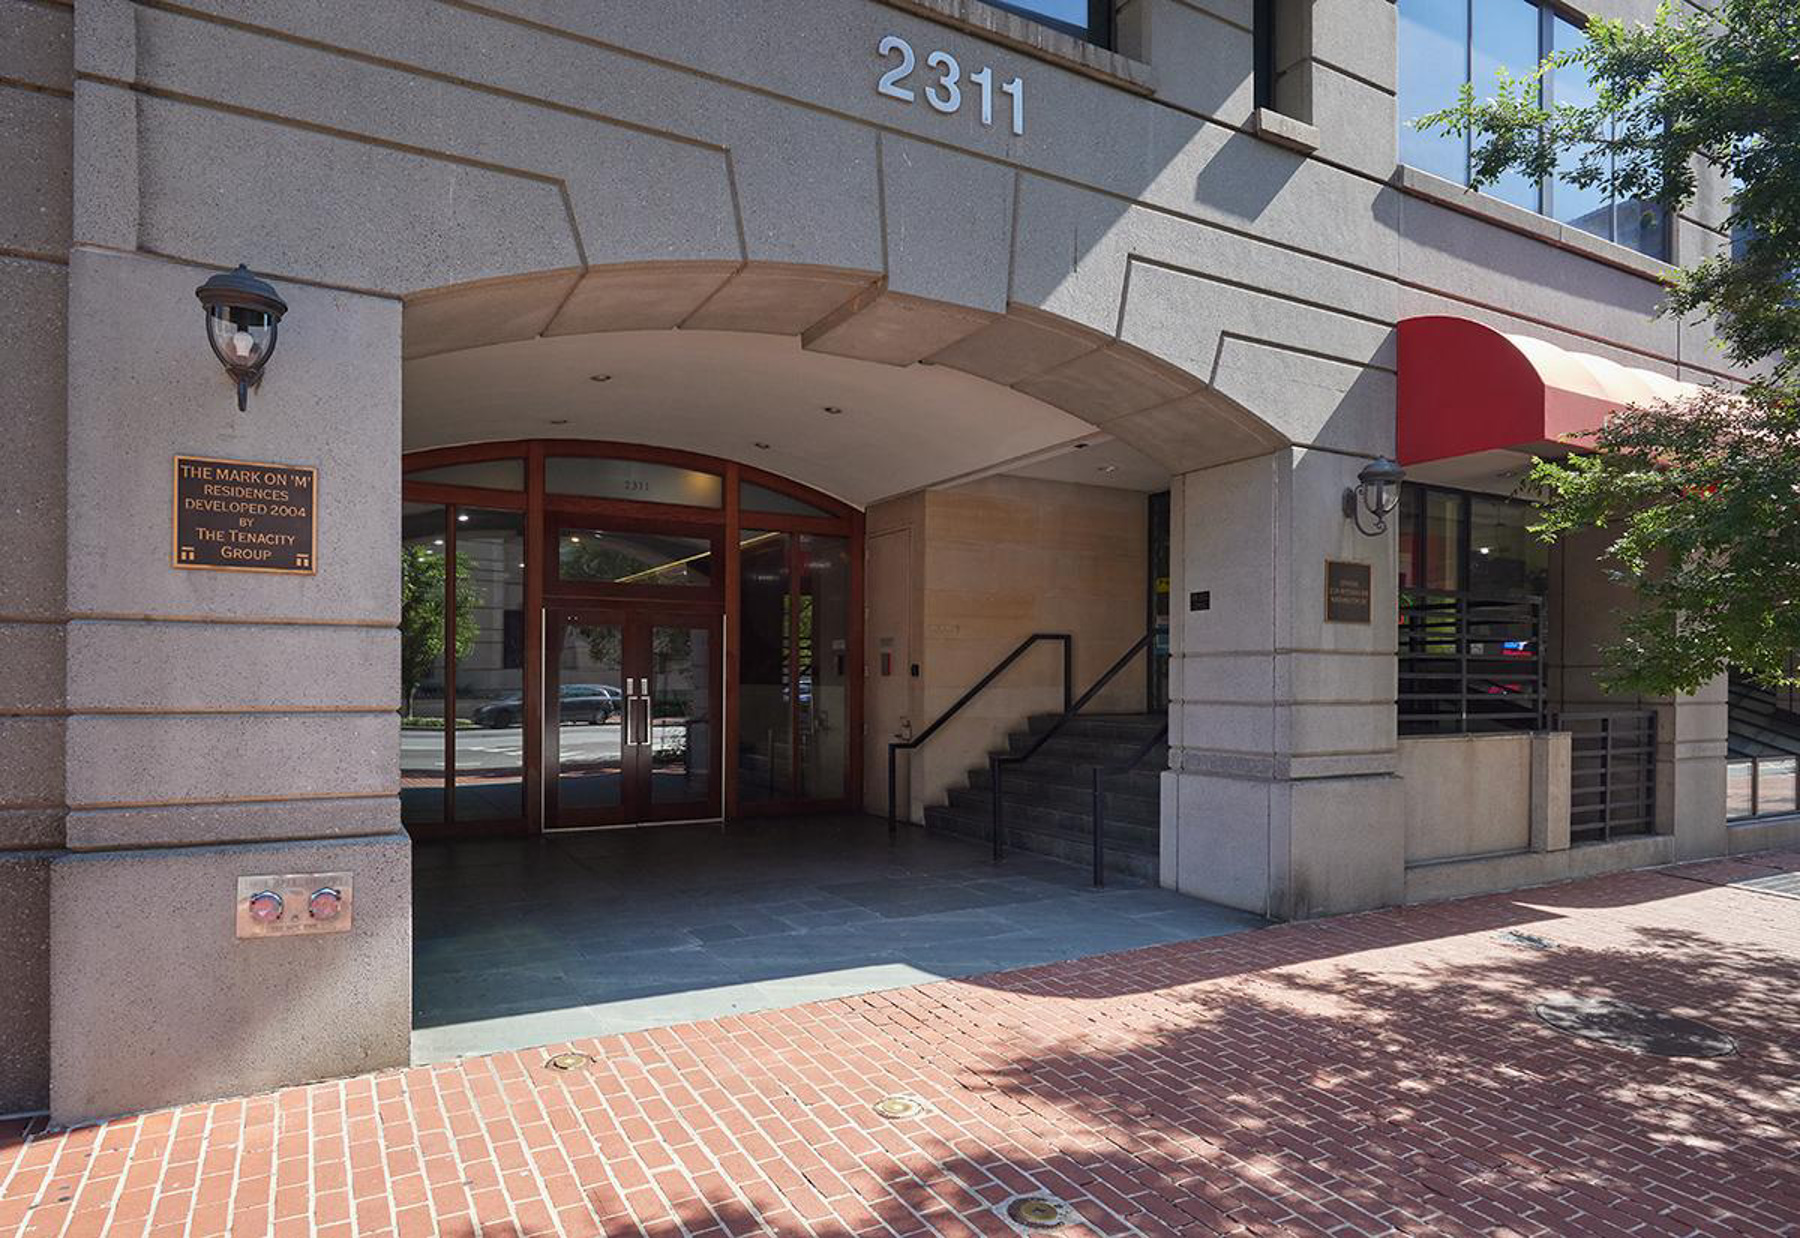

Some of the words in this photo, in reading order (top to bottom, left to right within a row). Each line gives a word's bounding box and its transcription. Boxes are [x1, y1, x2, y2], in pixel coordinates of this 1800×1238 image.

[878, 35, 1023, 136] 2311
[181, 464, 212, 479] THE
[216, 468, 261, 483] MARK
[264, 473, 288, 486] ON
[204, 484, 289, 500] RESIDENCES
[185, 498, 267, 514] DEVELOPED
[270, 504, 306, 517] 2004
[239, 517, 255, 527] BY
